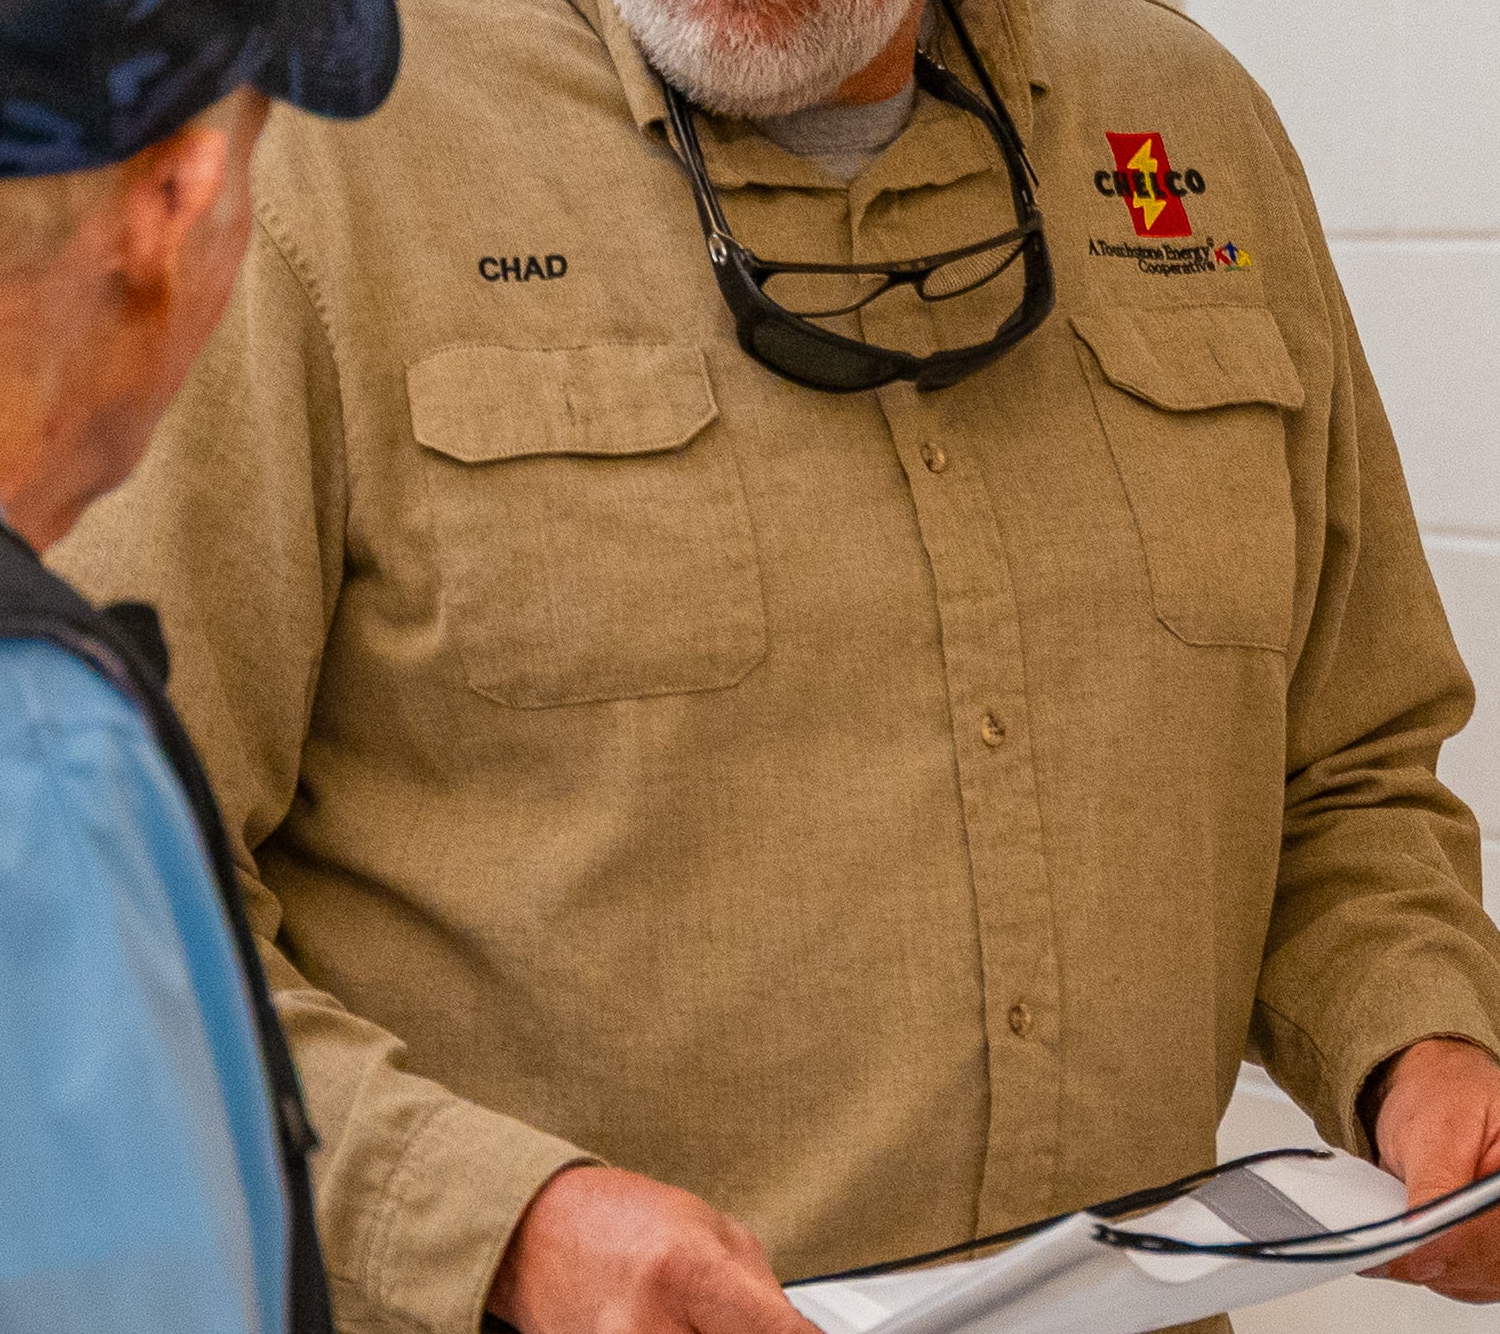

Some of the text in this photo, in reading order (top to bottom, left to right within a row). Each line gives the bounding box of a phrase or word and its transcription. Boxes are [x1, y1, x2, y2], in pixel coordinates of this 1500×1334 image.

[1093, 168, 1207, 198] CHELCO
[1162, 244, 1210, 263] Energy
[478, 254, 568, 282] CHAD
[1138, 257, 1216, 277] Cooperative
